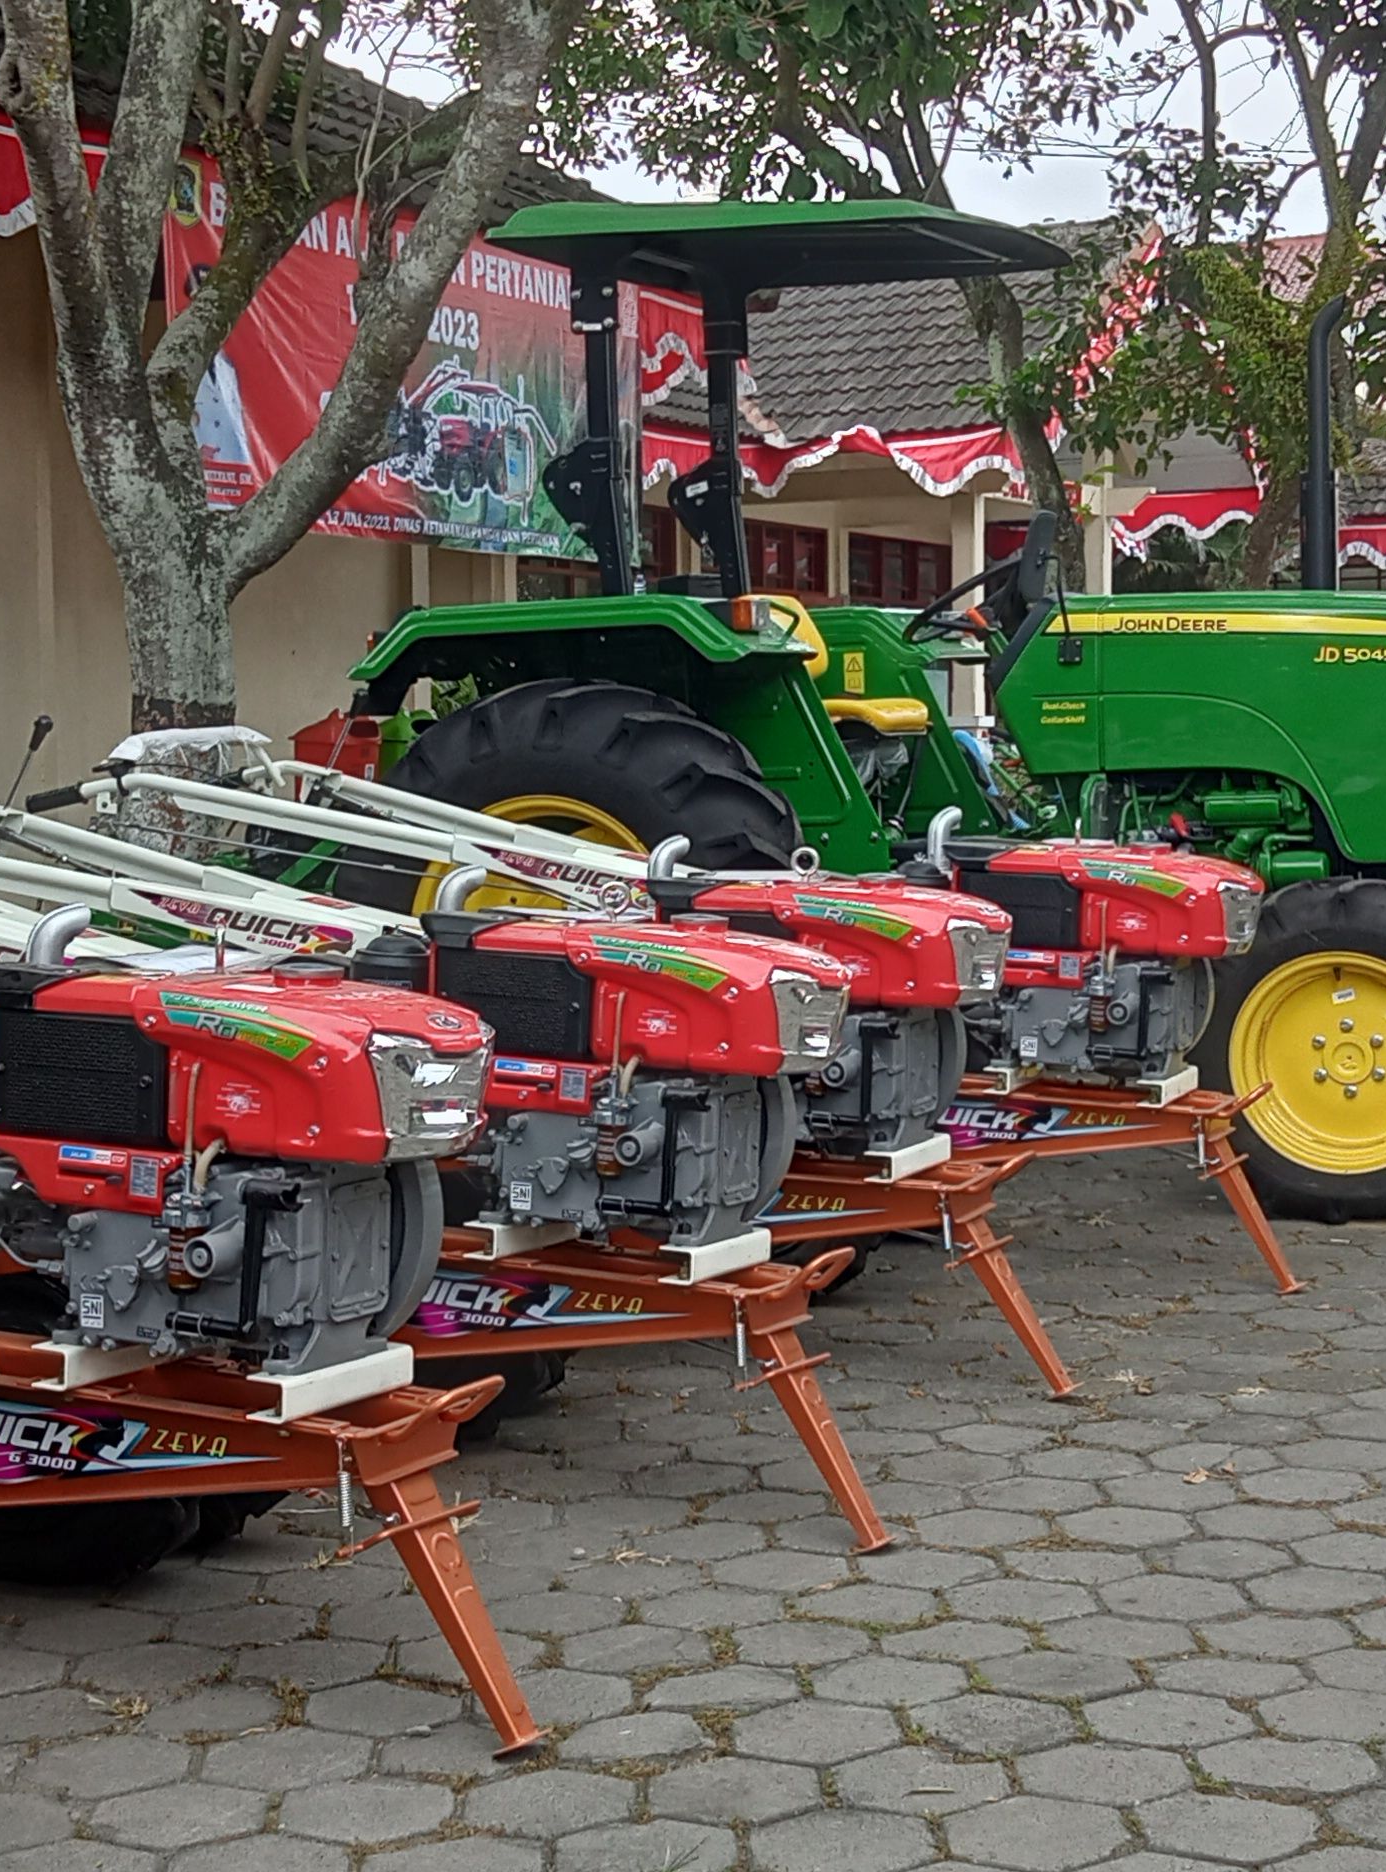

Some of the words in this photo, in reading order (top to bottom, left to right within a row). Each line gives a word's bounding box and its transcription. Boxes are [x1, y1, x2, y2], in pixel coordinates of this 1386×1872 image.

[471, 251, 571, 310] PERTANIA
[427, 306, 479, 351] 2023
[1114, 617, 1164, 632] JOHN
[1165, 617, 1227, 632] DEERE
[1313, 645, 1340, 664] JD
[205, 907, 315, 943] QUICK
[258, 937, 296, 949] 3000
[937, 1106, 1020, 1131] UICK
[1071, 1111, 1126, 1127] ZEVA
[980, 1131, 1018, 1140] 3000
[513, 1187, 530, 1199] SNI
[785, 1194, 846, 1211] ZEVA
[421, 1278, 509, 1313] UICK
[574, 1291, 644, 1315] ZEVA
[82, 1300, 102, 1315] SNI
[443, 1311, 455, 1320] G
[459, 1313, 506, 1327] 3000
[152, 1428, 229, 1459] ZEVA
[8, 1451, 21, 1463] G
[25, 1454, 77, 1471] 3000
